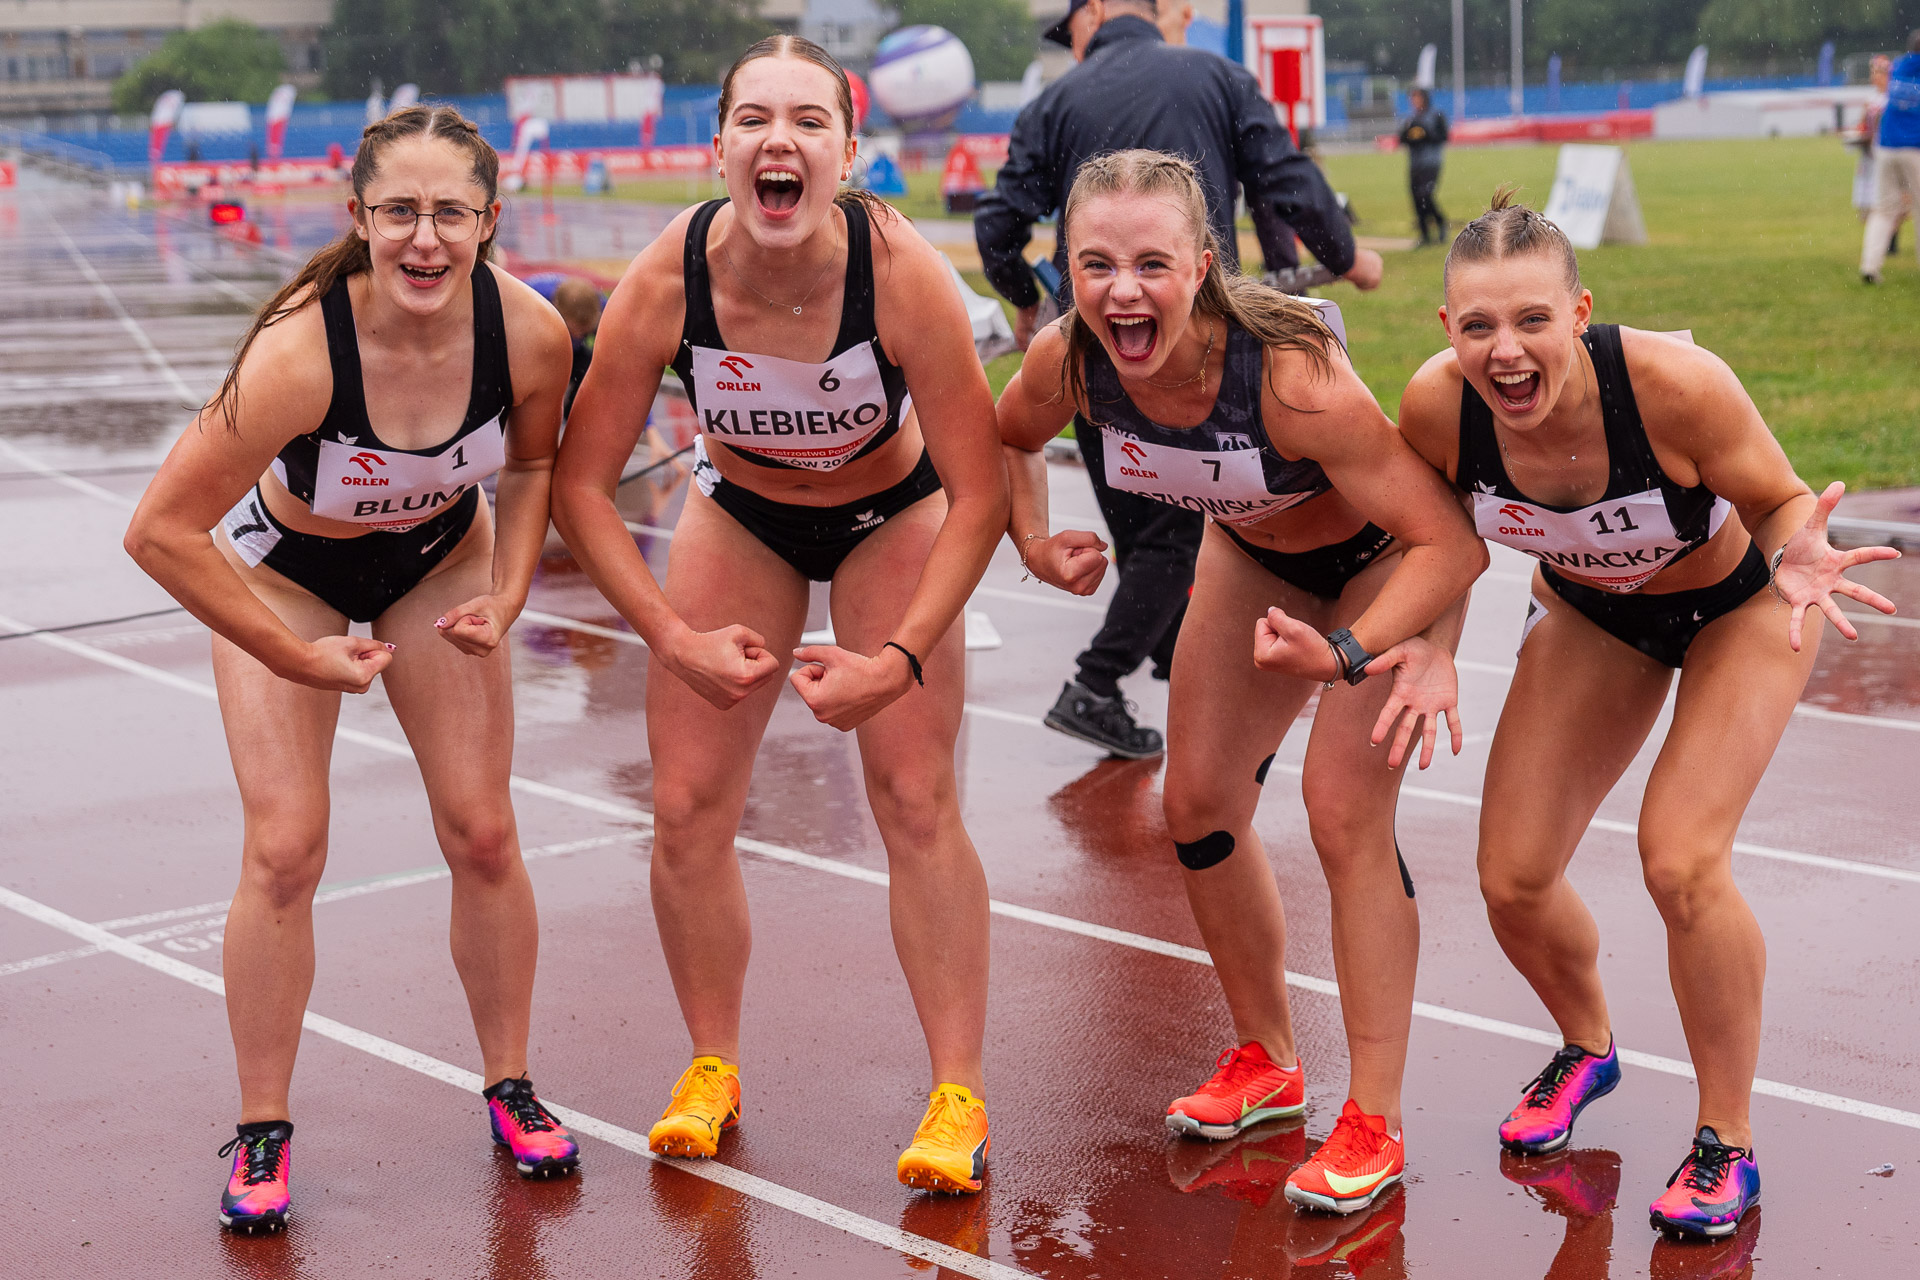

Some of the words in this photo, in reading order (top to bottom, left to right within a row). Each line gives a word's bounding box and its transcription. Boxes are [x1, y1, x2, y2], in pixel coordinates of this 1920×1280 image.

[715, 380, 762, 392] ORLEN
[818, 368, 841, 392] 6
[704, 402, 881, 435] KLEBIEKO
[451, 444, 469, 471] 1
[767, 448, 827, 458] Mistrzostwa
[341, 476, 390, 487] ORLEN
[1119, 465, 1160, 480] ORLEN
[1201, 459, 1222, 482] 7
[353, 484, 466, 517] BLUM
[231, 500, 270, 542] 7
[1498, 526, 1546, 537] ORLEN
[1589, 506, 1640, 535] 11
